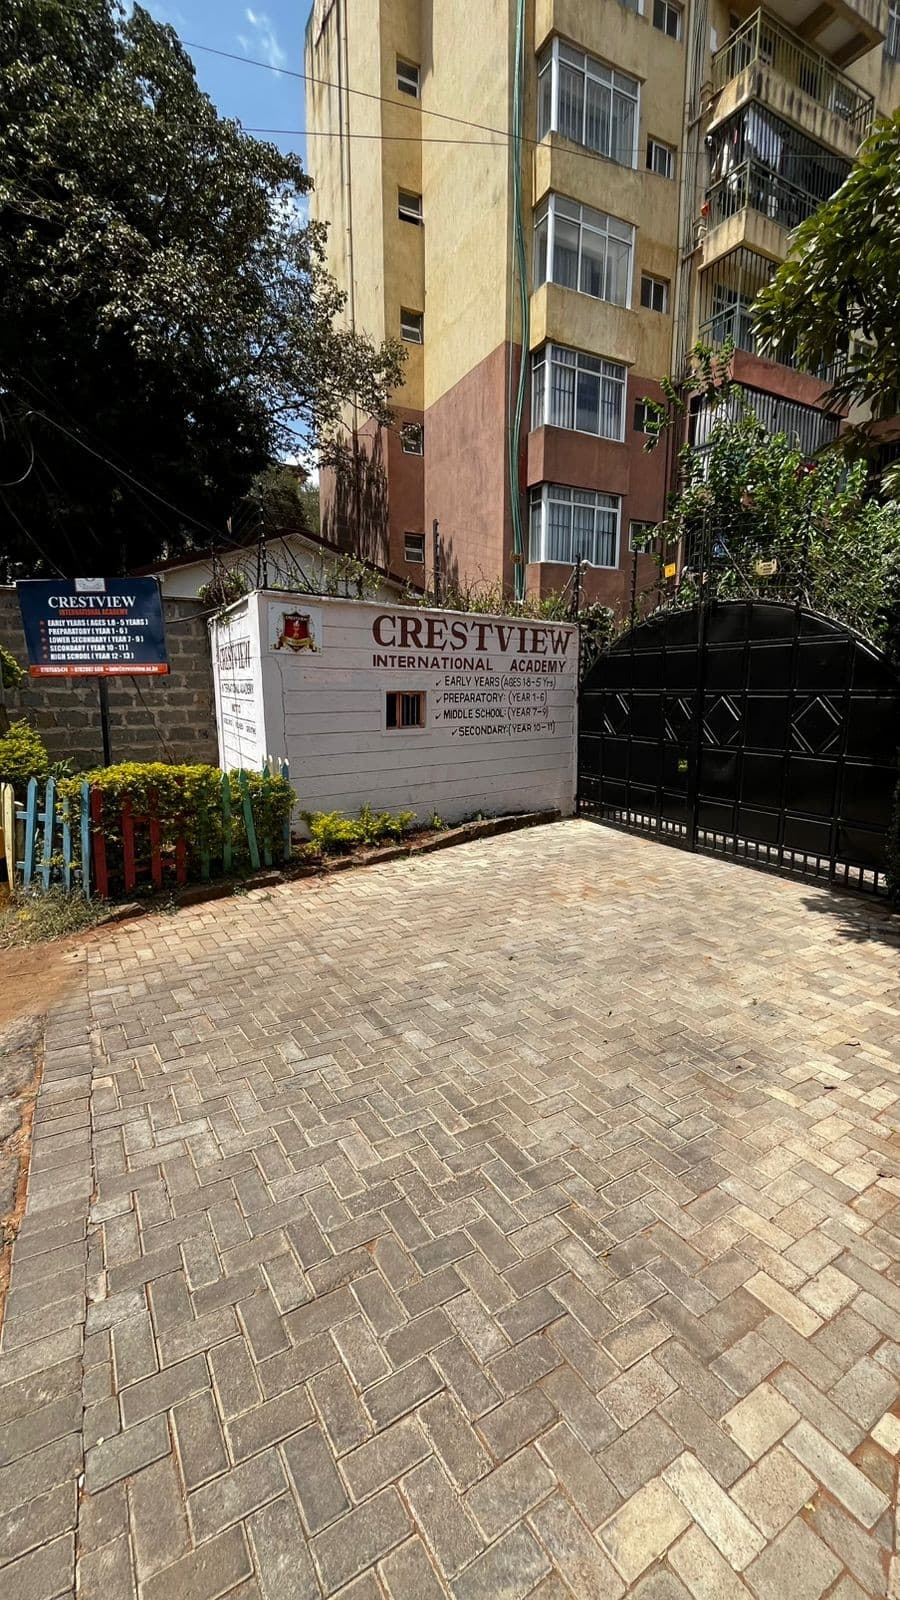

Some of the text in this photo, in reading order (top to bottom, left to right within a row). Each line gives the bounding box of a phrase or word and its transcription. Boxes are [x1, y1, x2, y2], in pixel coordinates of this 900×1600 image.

[48, 596, 136, 608] CRESTVIEW
[372, 615, 573, 656] CRESTVIEW
[373, 654, 566, 673] INTERNATIONAL ACADEMY
[445, 675, 471, 686] EARLY
[475, 677, 500, 687] YEARS
[444, 709, 474, 720] MIDDLE
